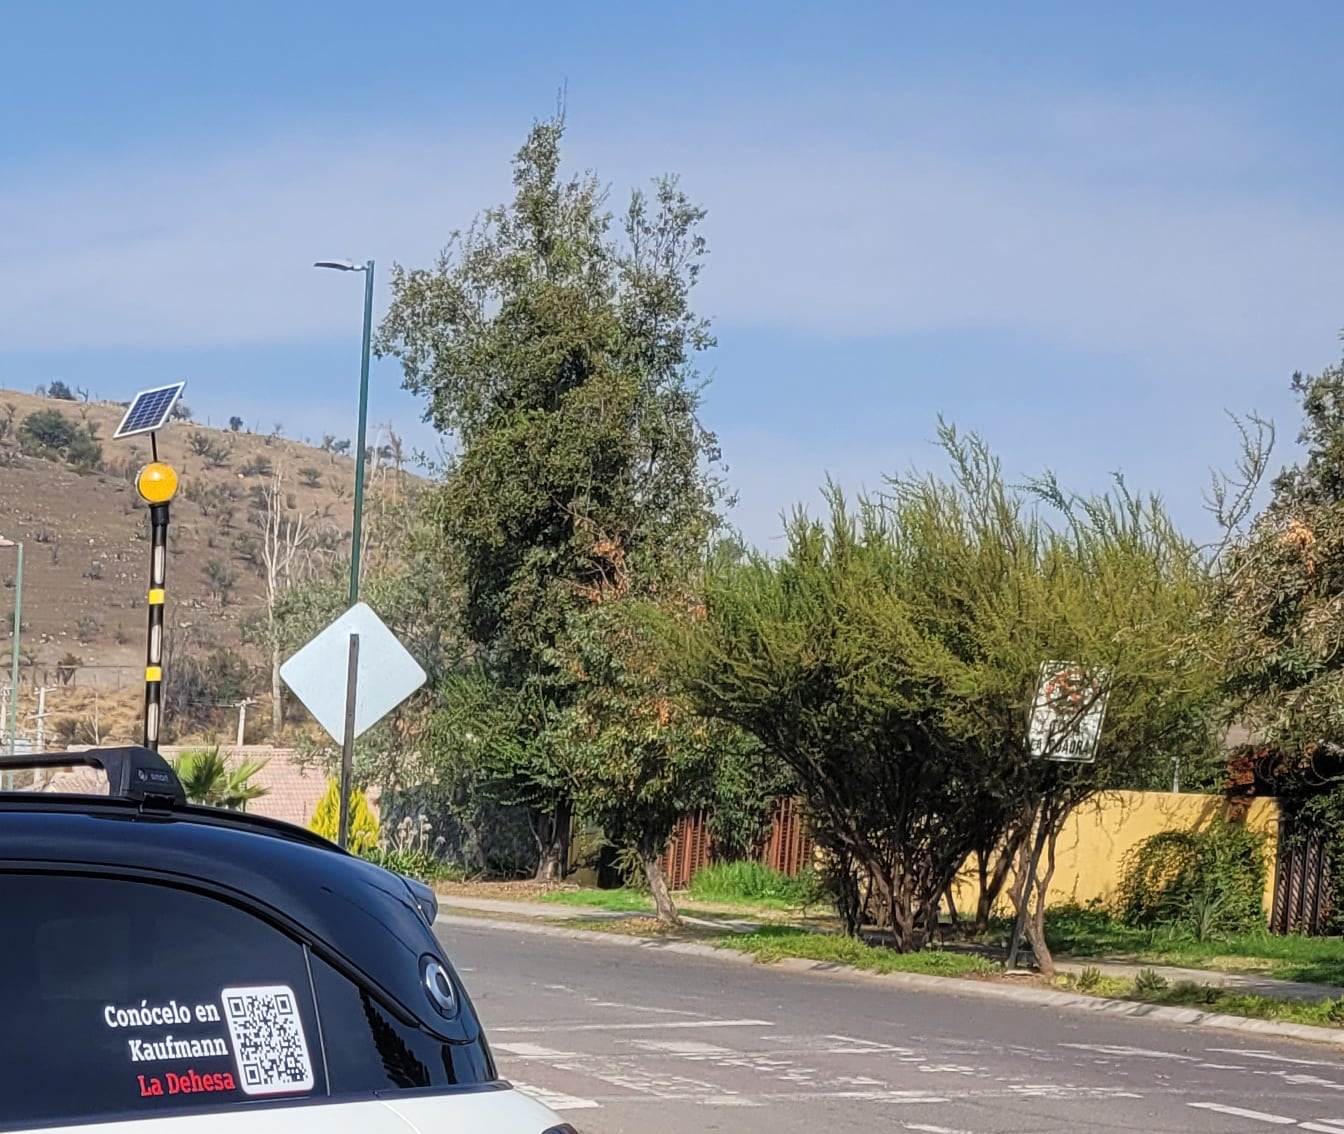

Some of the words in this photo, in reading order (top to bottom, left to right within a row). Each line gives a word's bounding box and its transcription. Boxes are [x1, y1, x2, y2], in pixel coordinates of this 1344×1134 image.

[103, 999, 192, 1028] Conócelo
[195, 1003, 221, 1022] en
[128, 1035, 229, 1062] Kaufmann
[137, 1074, 163, 1097] La
[165, 1069, 236, 1095] Dehesa
